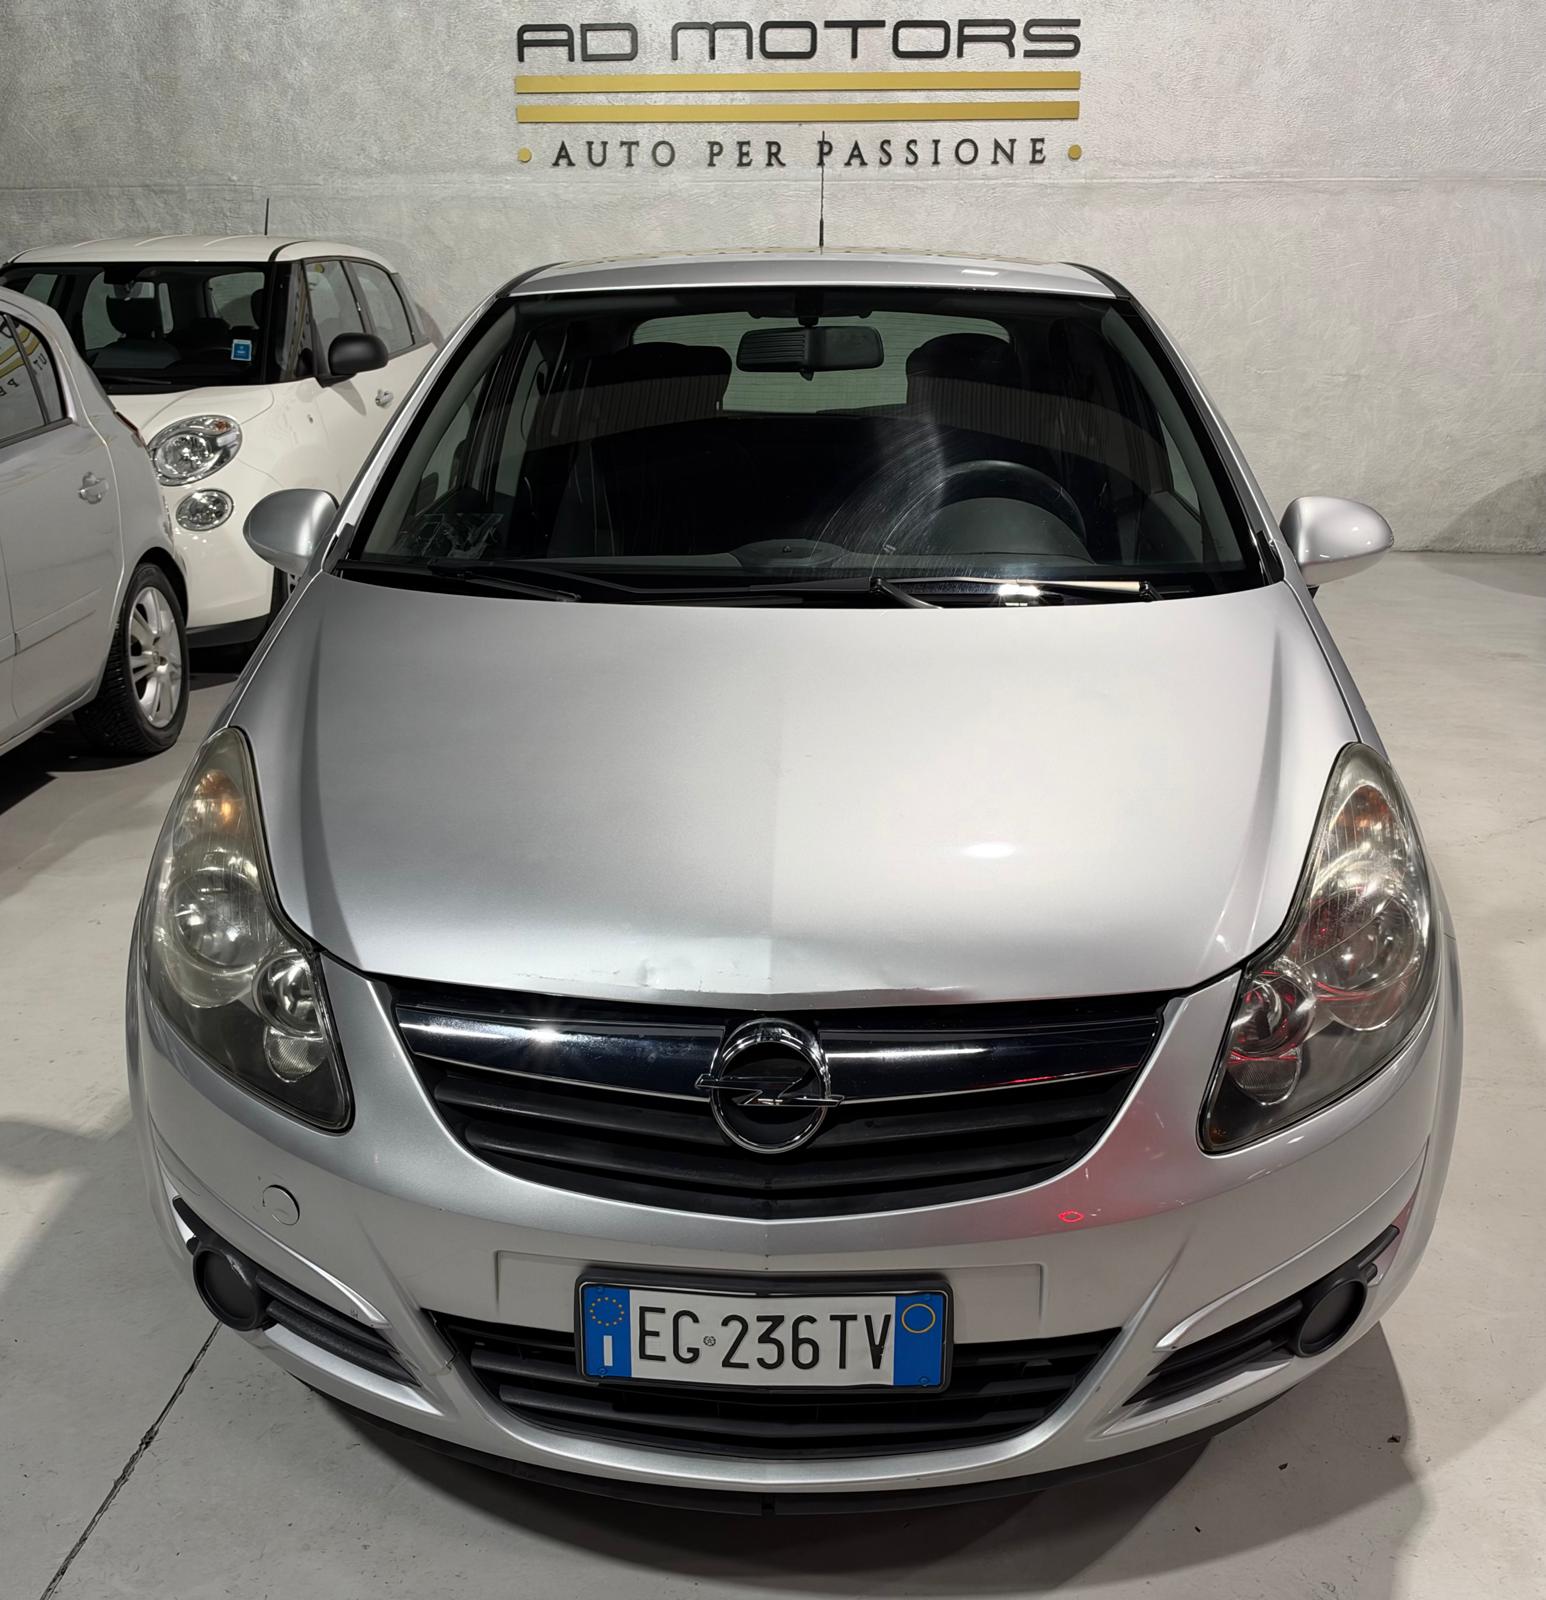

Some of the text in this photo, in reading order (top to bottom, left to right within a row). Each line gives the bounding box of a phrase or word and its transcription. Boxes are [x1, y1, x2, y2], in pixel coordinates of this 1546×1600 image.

[517, 19, 1081, 62] AD MOTORS
[552, 138, 1046, 167] AUTO PER PASSIONE
